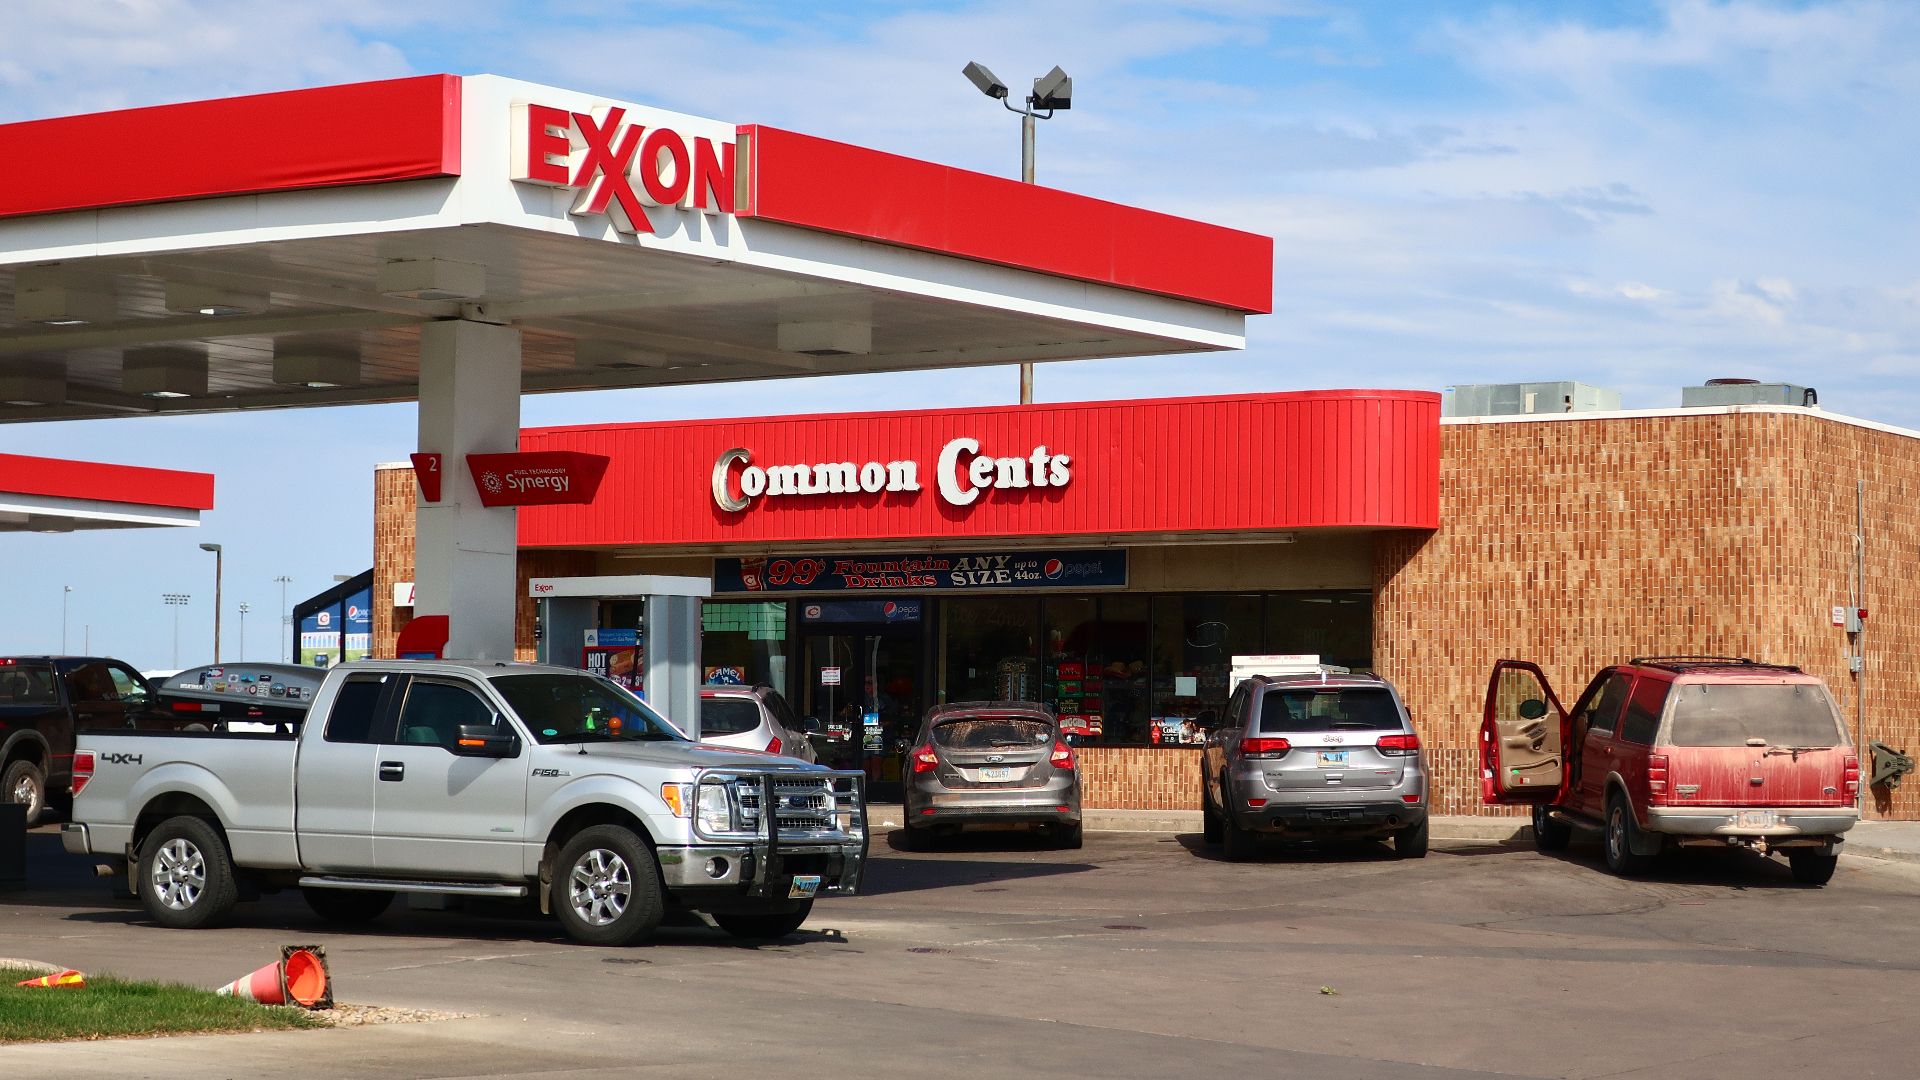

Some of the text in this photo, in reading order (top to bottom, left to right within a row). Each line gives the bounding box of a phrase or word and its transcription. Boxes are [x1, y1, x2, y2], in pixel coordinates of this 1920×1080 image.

[527, 103, 735, 234] EXXON
[429, 457, 437, 472] 2
[712, 438, 1071, 512] Common Cents
[505, 473, 569, 493] Synergy
[832, 556, 950, 575] Fountain
[952, 555, 1012, 571] ANY
[1014, 560, 1038, 569] up to
[843, 573, 938, 589] Drinks
[950, 570, 1012, 586] SIZE
[534, 583, 554, 594] Exxon
[898, 605, 918, 614] pepsi
[588, 653, 606, 667] HOT
[709, 667, 741, 681] CAMEL
[1323, 735, 1345, 743] Jeep
